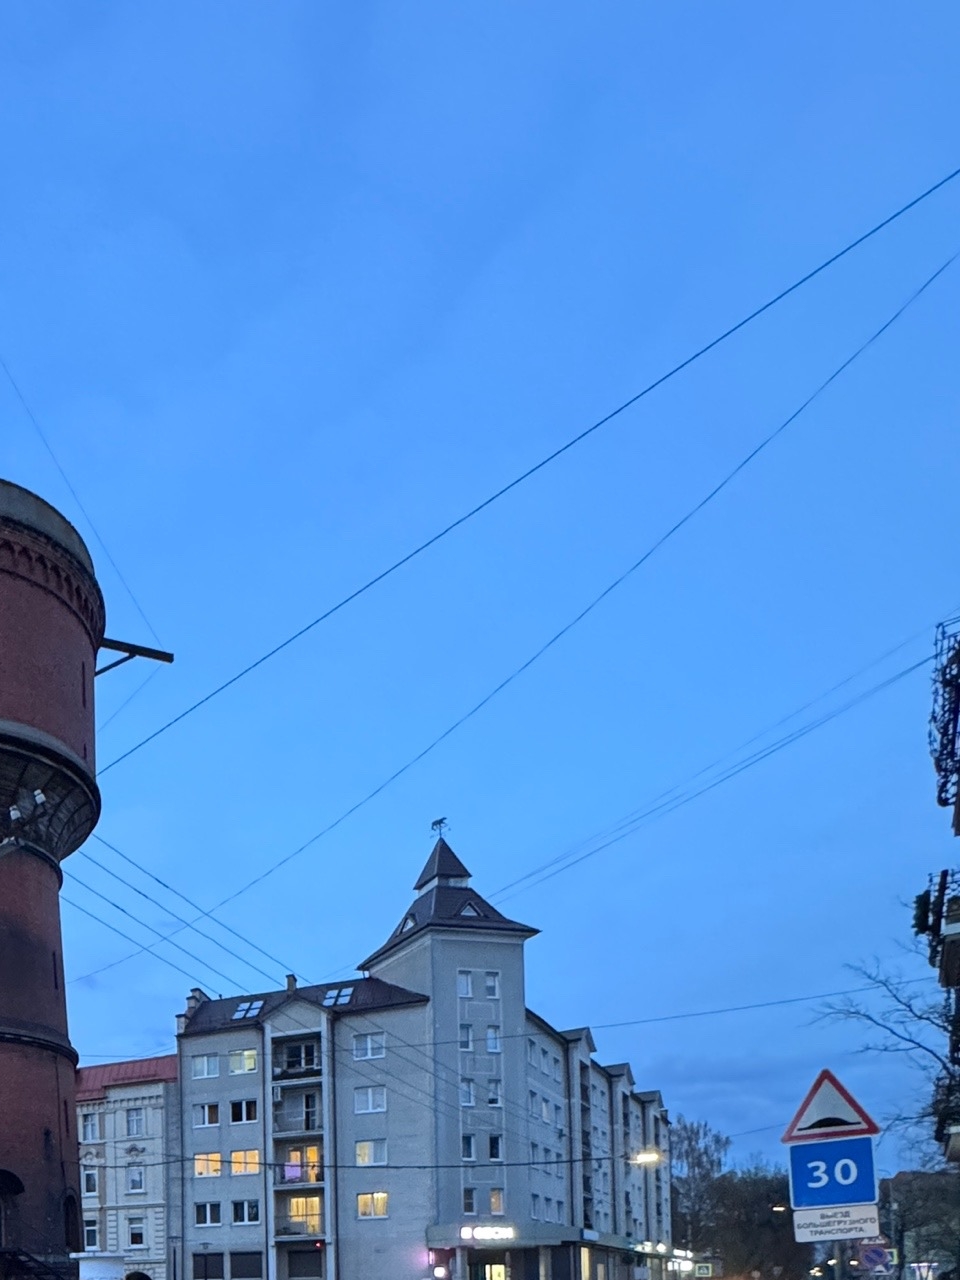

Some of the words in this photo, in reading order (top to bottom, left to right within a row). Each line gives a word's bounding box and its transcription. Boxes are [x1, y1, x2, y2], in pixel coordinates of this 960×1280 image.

[807, 1158, 858, 1188] 30
[820, 1210, 851, 1220] ВЫЕЗД
[797, 1217, 877, 1230] БОЛЬШЕГРУЗНОГО
[809, 1226, 865, 1237] ТРАНСПОРТА
